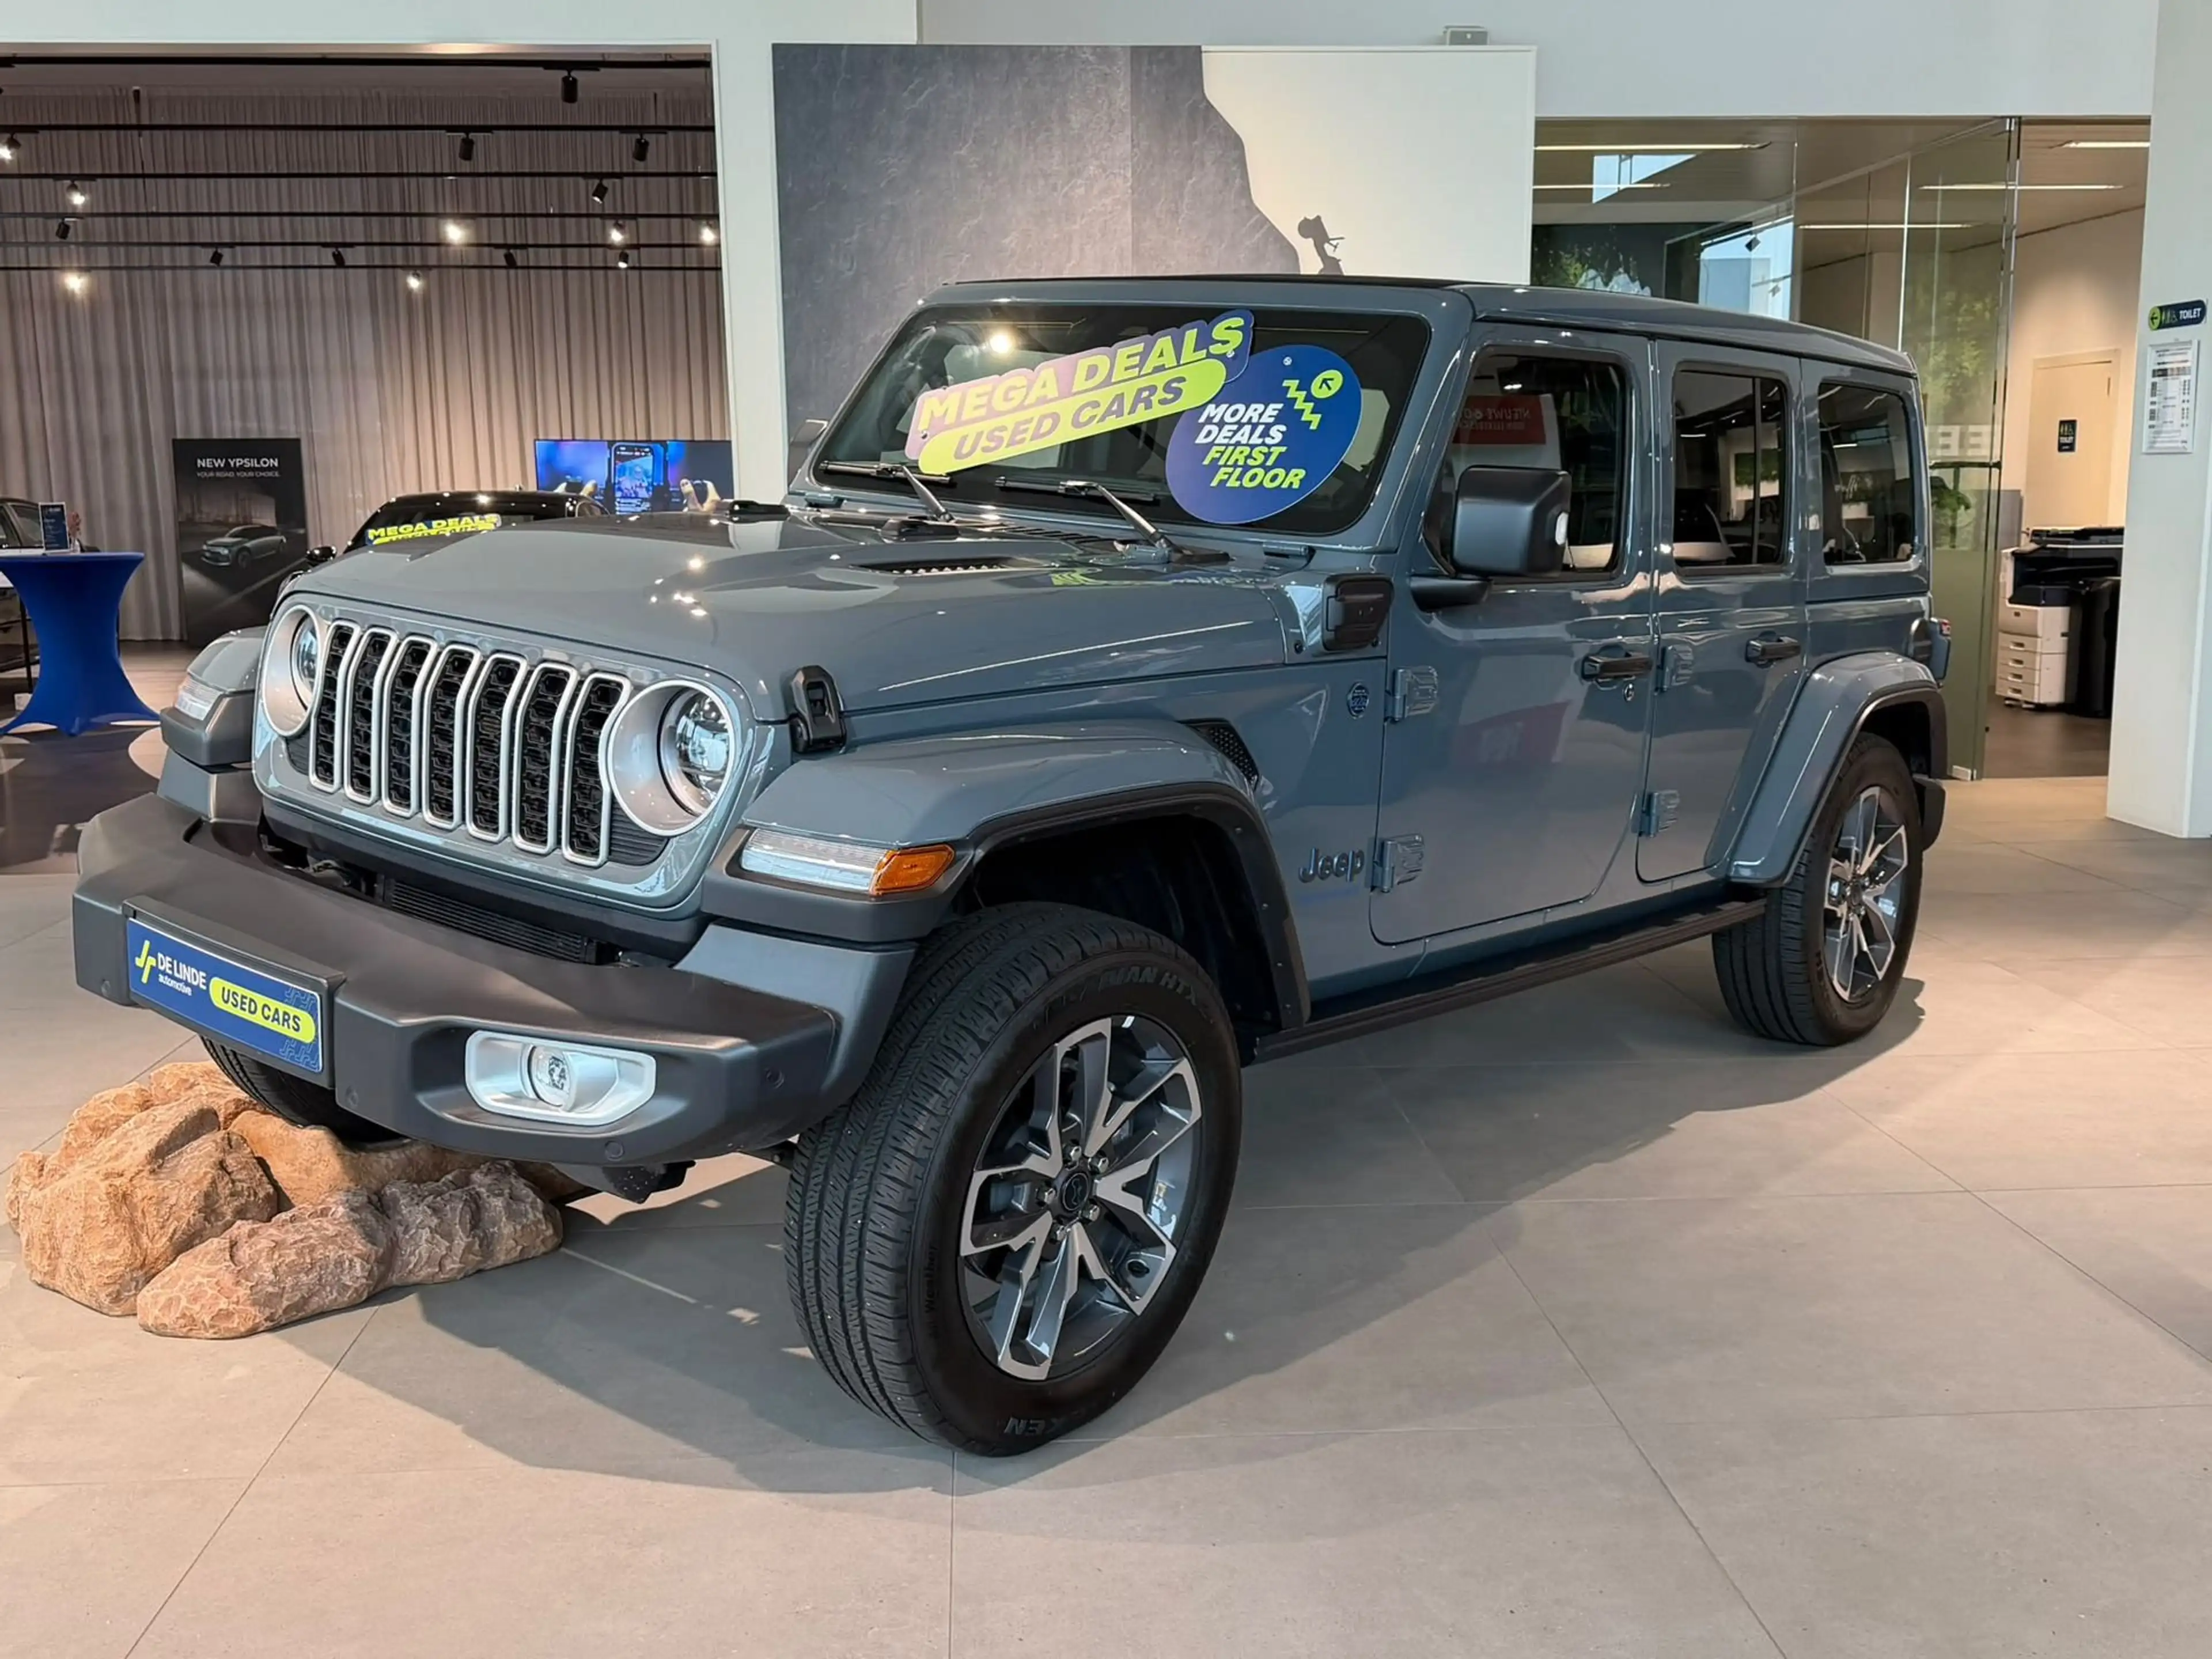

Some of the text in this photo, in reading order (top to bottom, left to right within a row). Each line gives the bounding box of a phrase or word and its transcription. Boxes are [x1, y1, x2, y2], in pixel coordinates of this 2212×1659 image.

[2179, 308, 2202, 320] TOILET
[918, 317, 1245, 430] MEGA DEALS
[953, 376, 1187, 460] USED CARS
[1198, 403, 1284, 423] MORE
[1194, 424, 1287, 445] DEALS
[196, 457, 279, 468] NEW YPSILON
[1202, 445, 1287, 466] FIRST
[1210, 467, 1306, 489] FLOOR
[369, 522, 429, 540] MEGA
[432, 514, 499, 529] DEALS
[1298, 847, 1365, 883] Jeep
[157, 952, 207, 990] DE LINDE
[221, 986, 301, 1033] USED CARS
